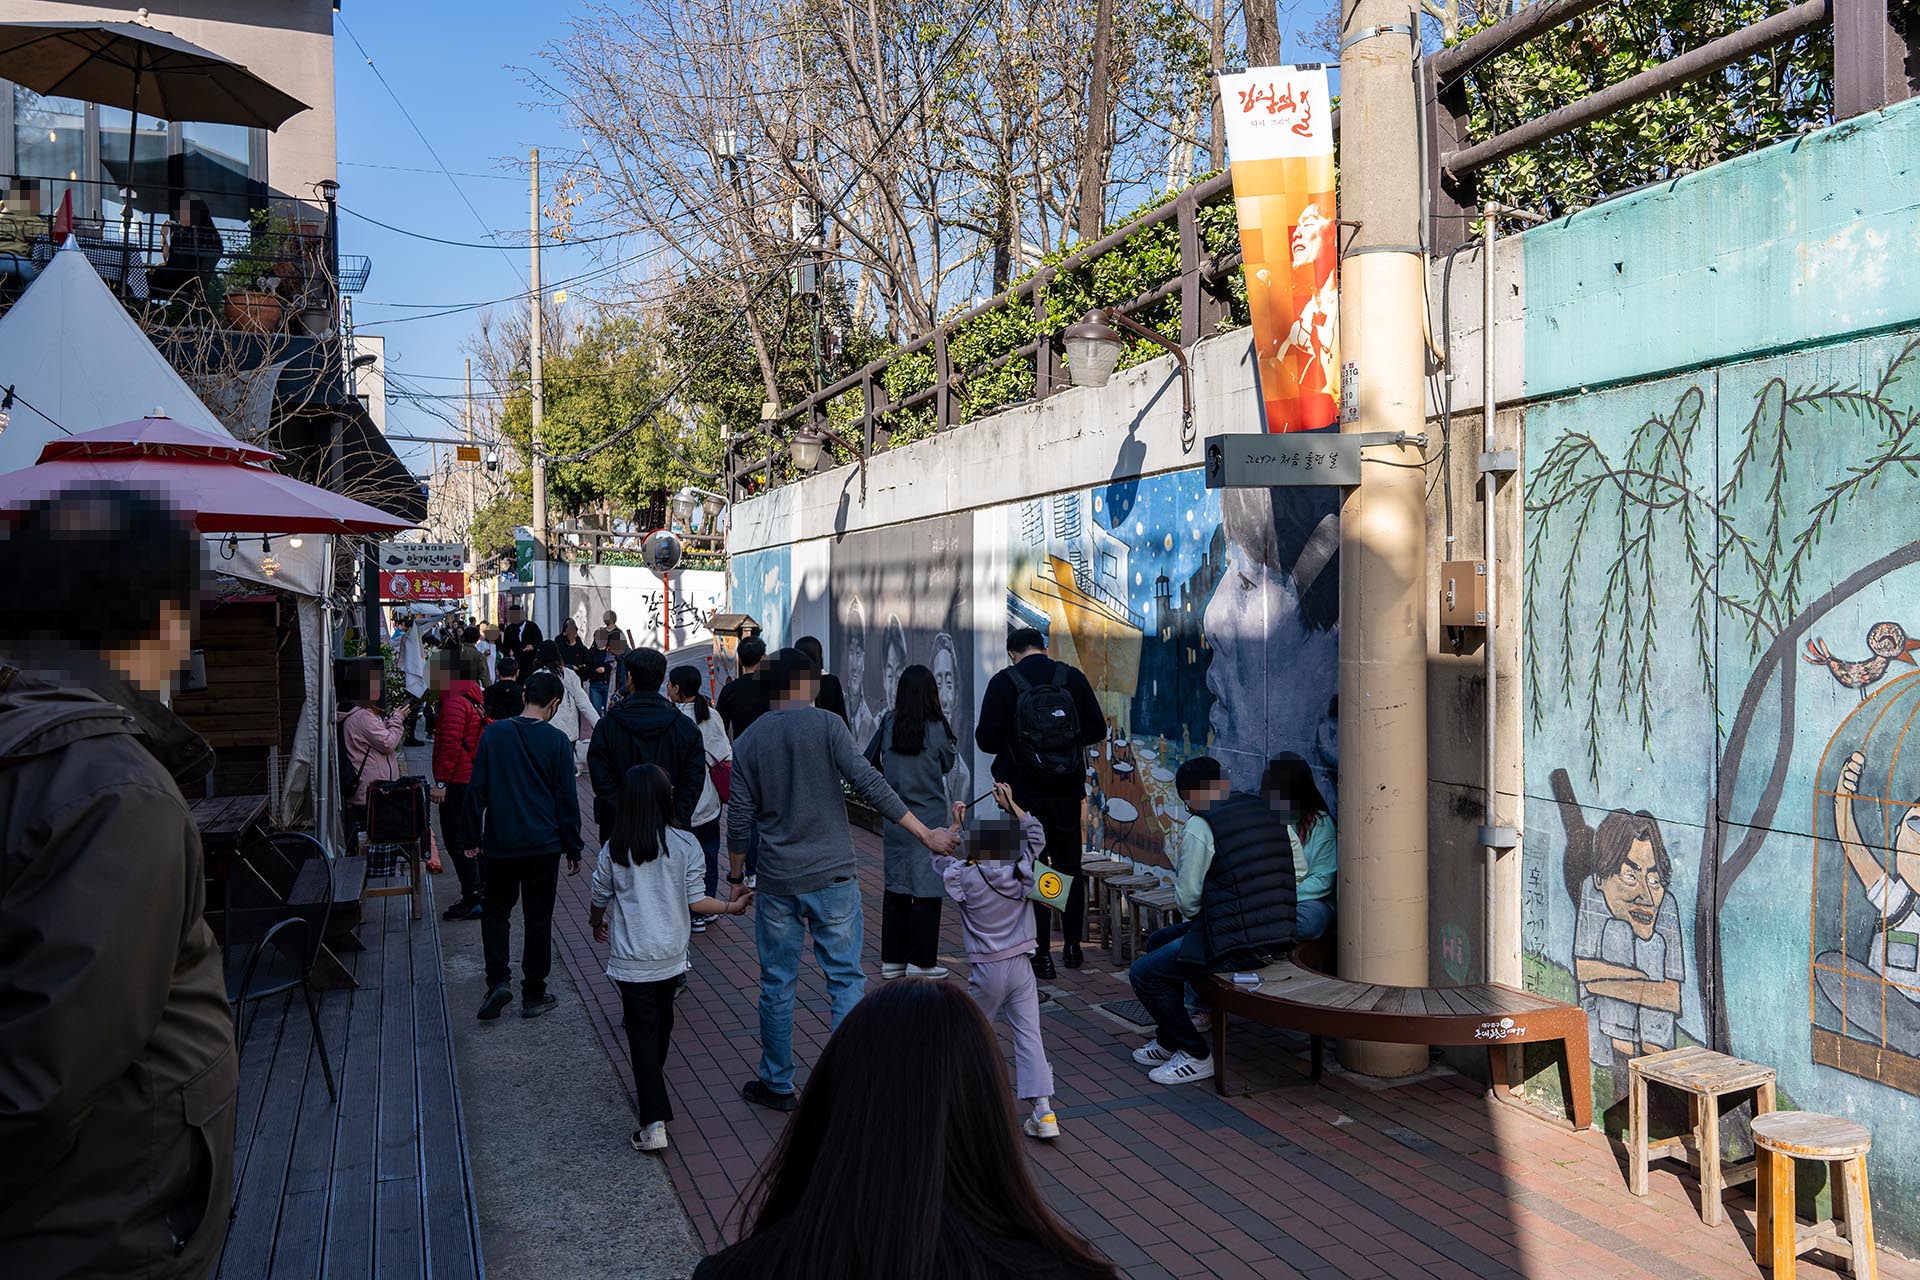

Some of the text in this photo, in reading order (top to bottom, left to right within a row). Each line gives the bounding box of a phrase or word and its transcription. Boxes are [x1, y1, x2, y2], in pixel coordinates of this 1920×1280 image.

[1245, 451, 1339, 471] 그녀가 처음 울던 날
